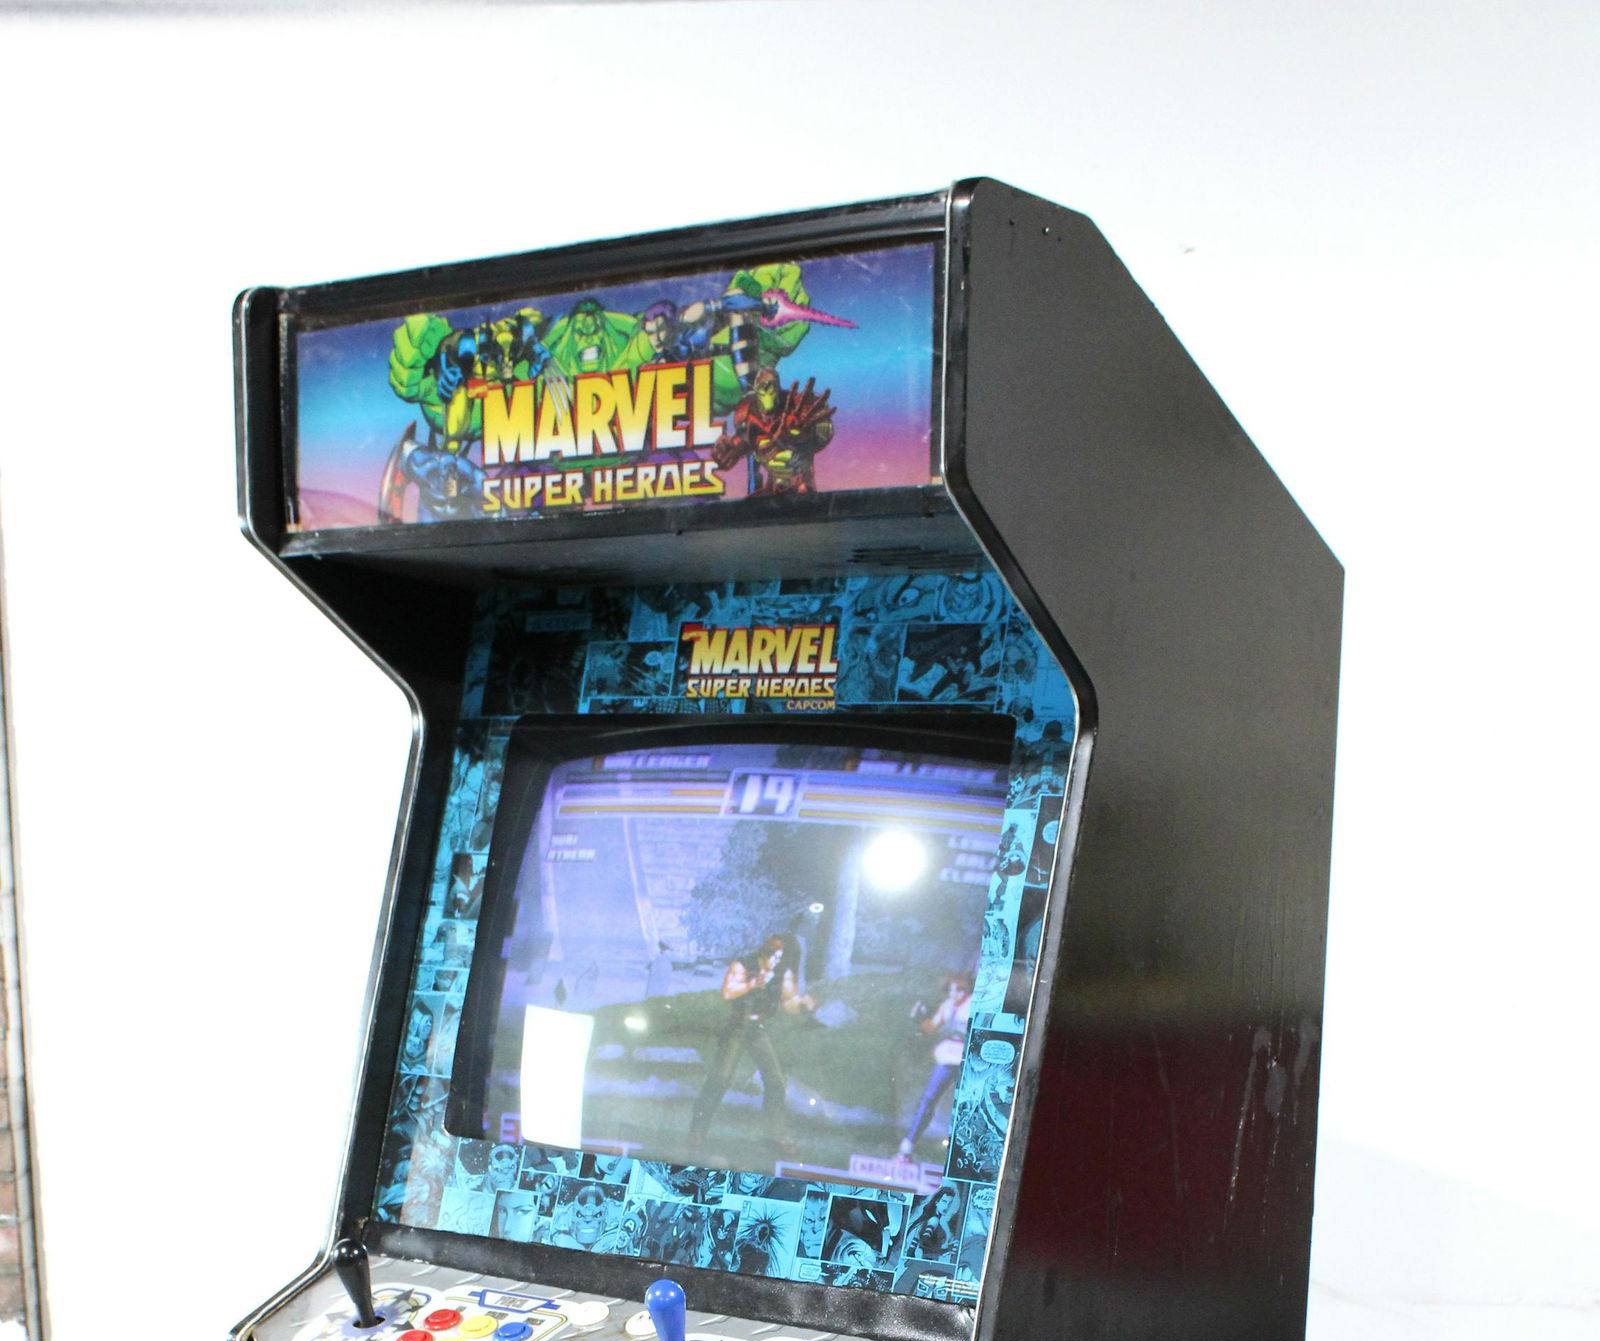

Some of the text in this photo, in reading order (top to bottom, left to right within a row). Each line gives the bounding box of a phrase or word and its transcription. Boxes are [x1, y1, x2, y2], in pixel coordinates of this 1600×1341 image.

[472, 358, 724, 466] MARVEL
[482, 460, 725, 512] SUPER HEROES
[682, 623, 839, 675] MARVEL
[686, 675, 838, 698] SUPER HEROES
[786, 699, 836, 711] CAPCOM
